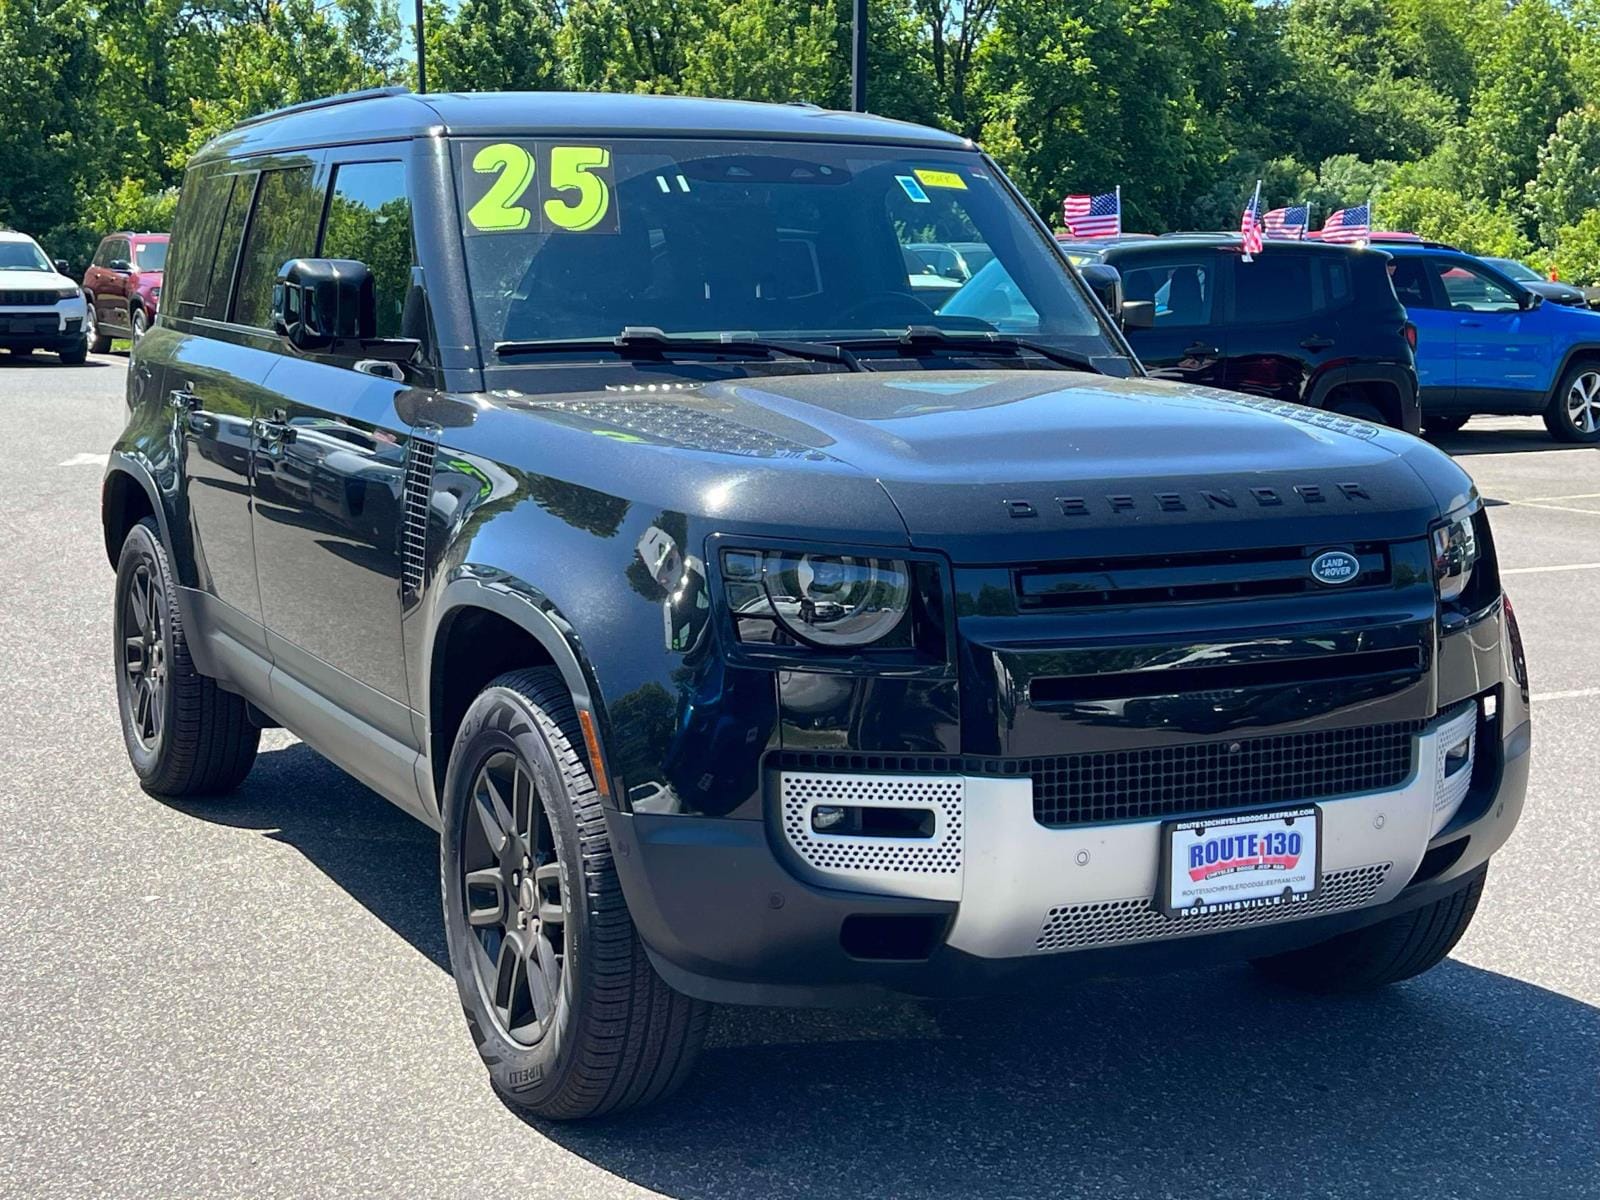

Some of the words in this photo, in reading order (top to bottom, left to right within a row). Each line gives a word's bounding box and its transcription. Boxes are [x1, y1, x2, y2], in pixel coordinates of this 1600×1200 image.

[467, 143, 610, 232] 25
[1002, 481, 1371, 519] DEFENDER
[1321, 558, 1344, 568] LAND
[1324, 566, 1351, 577] ROVER
[1189, 833, 1259, 868] ROUTE
[1262, 832, 1302, 856] 130
[1291, 893, 1308, 902] NJ
